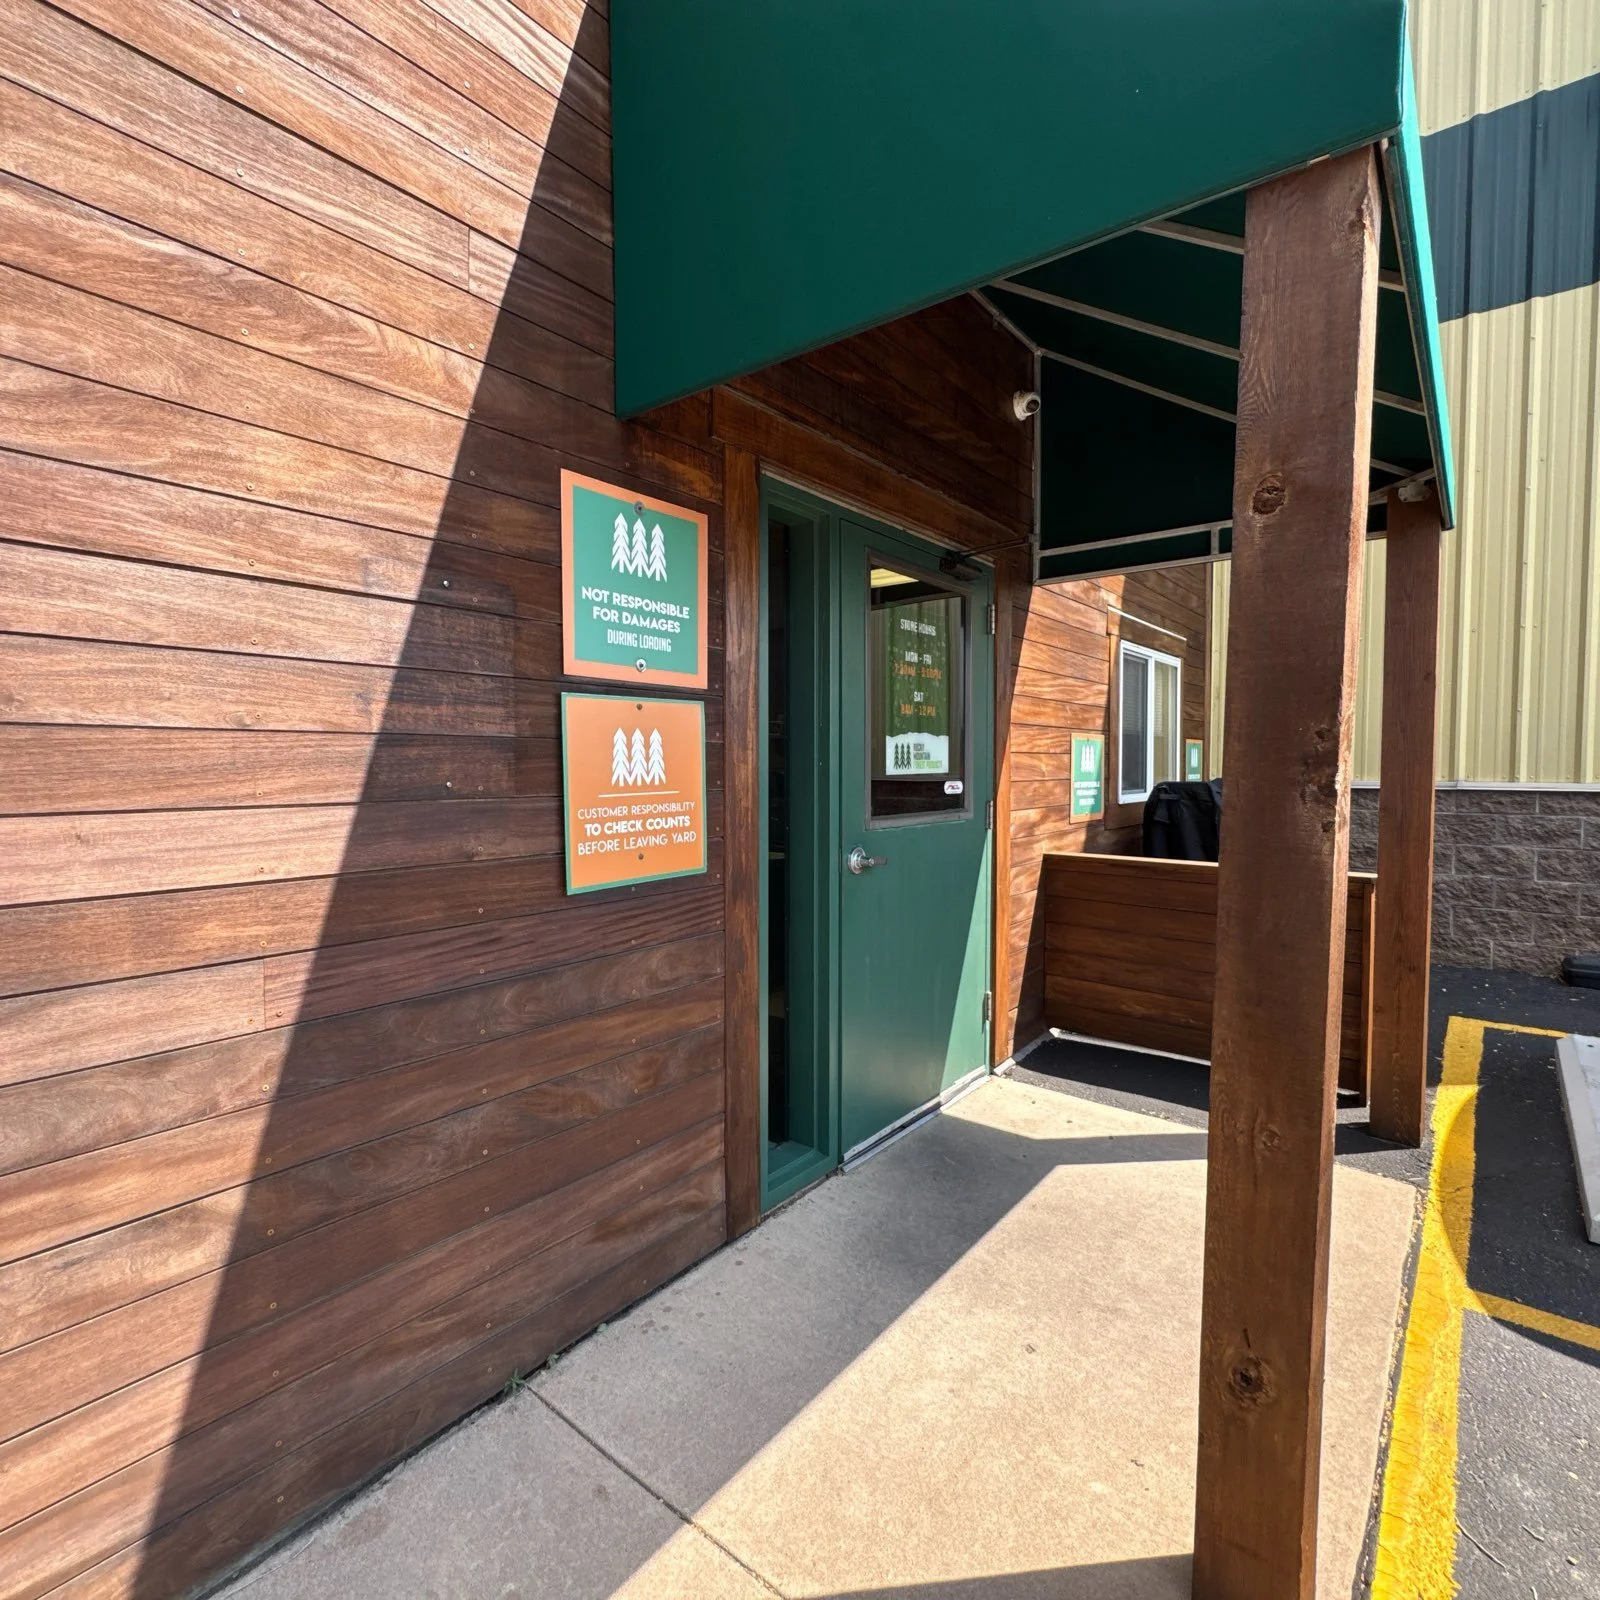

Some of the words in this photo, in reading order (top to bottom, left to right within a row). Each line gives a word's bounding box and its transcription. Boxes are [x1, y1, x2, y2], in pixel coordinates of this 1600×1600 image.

[581, 586, 609, 603] NOT
[612, 592, 690, 619] RESPONSIBLE
[592, 606, 619, 623] FOR
[622, 611, 680, 633] DAMAGES
[900, 618, 918, 633] STORE
[918, 622, 936, 636] HOURS
[607, 628, 638, 647] DURING
[639, 633, 672, 652] LOADING
[905, 650, 918, 663] MON
[923, 653, 932, 665] FRI
[913, 691, 924, 702] SAT
[577, 806, 628, 820] CUSTOMER
[631, 801, 695, 815] RESPONSIBILITY
[584, 823, 601, 836] TO
[603, 819, 644, 835] CHECK
[645, 815, 691, 830] COUNTS
[577, 839, 621, 855] BEFORE
[623, 834, 669, 850] LEAVING
[671, 831, 697, 844] YARD
